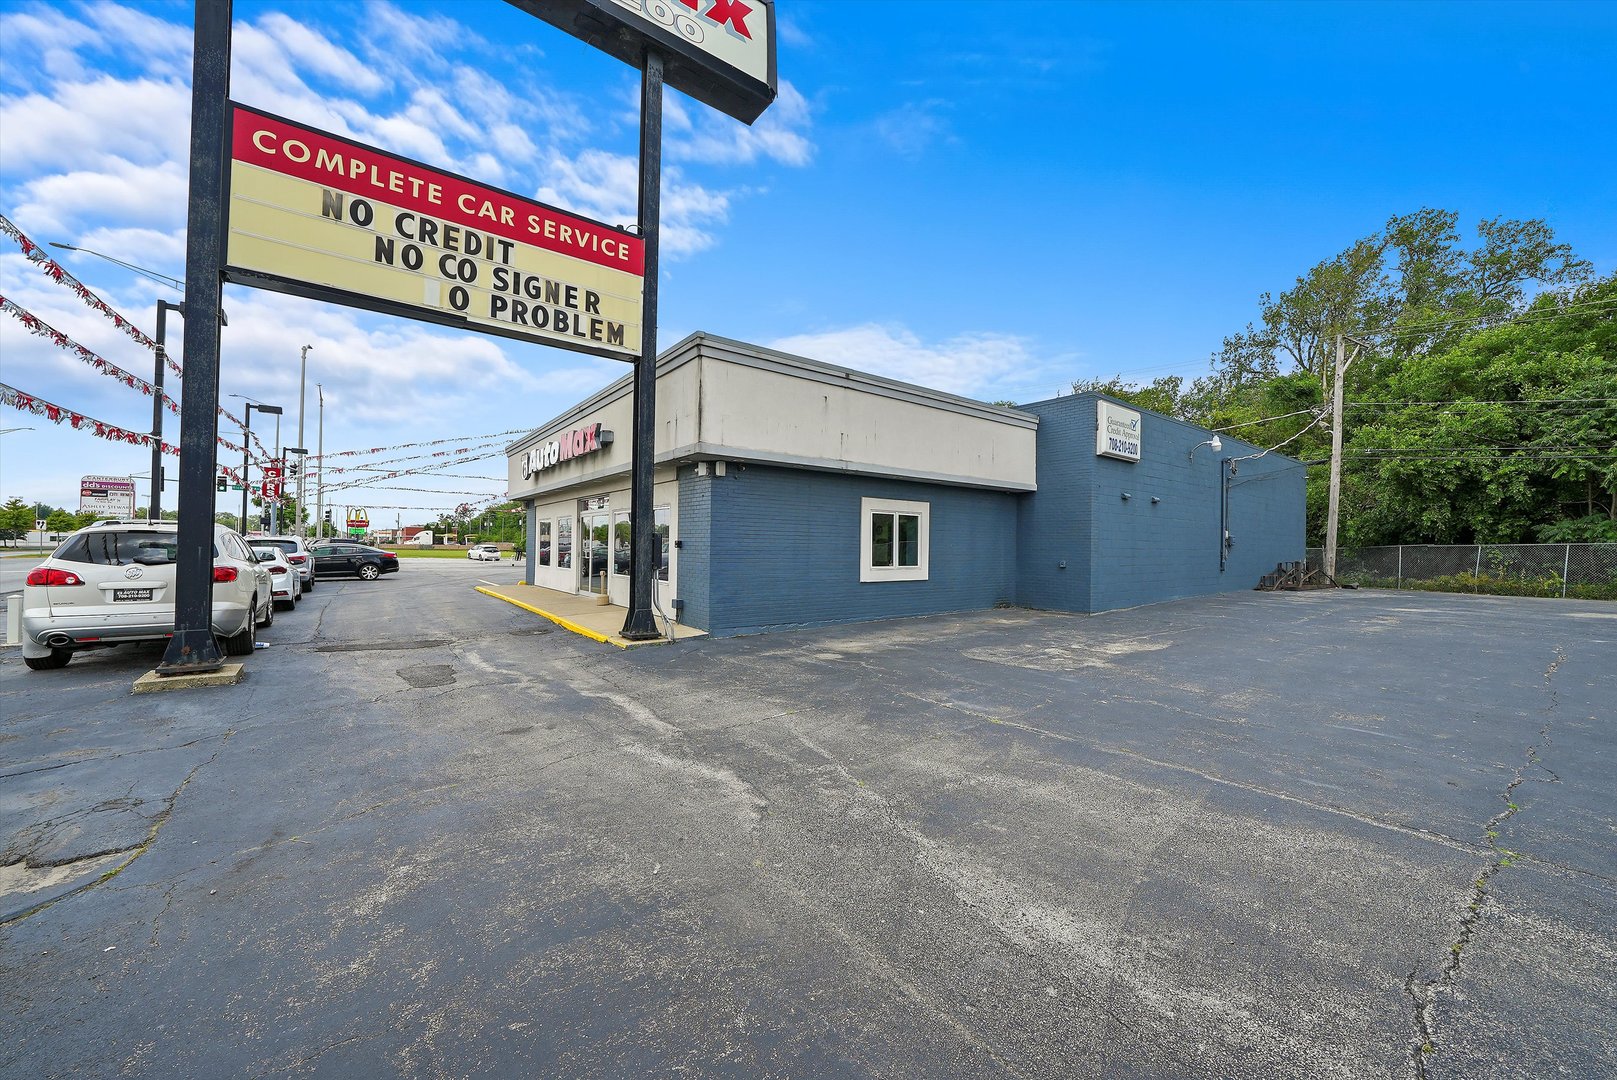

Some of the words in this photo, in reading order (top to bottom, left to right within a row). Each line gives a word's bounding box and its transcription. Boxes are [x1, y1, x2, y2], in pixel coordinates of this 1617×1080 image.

[252, 129, 443, 206] COMPLETE
[457, 193, 516, 227] CAR
[527, 214, 630, 261] SERVICE
[321, 188, 374, 227] NO
[395, 212, 515, 265] CREDIT
[375, 235, 424, 271] NO
[439, 253, 478, 284] CO
[493, 266, 601, 315] SIGNER
[490, 294, 624, 346] PROBLEM
